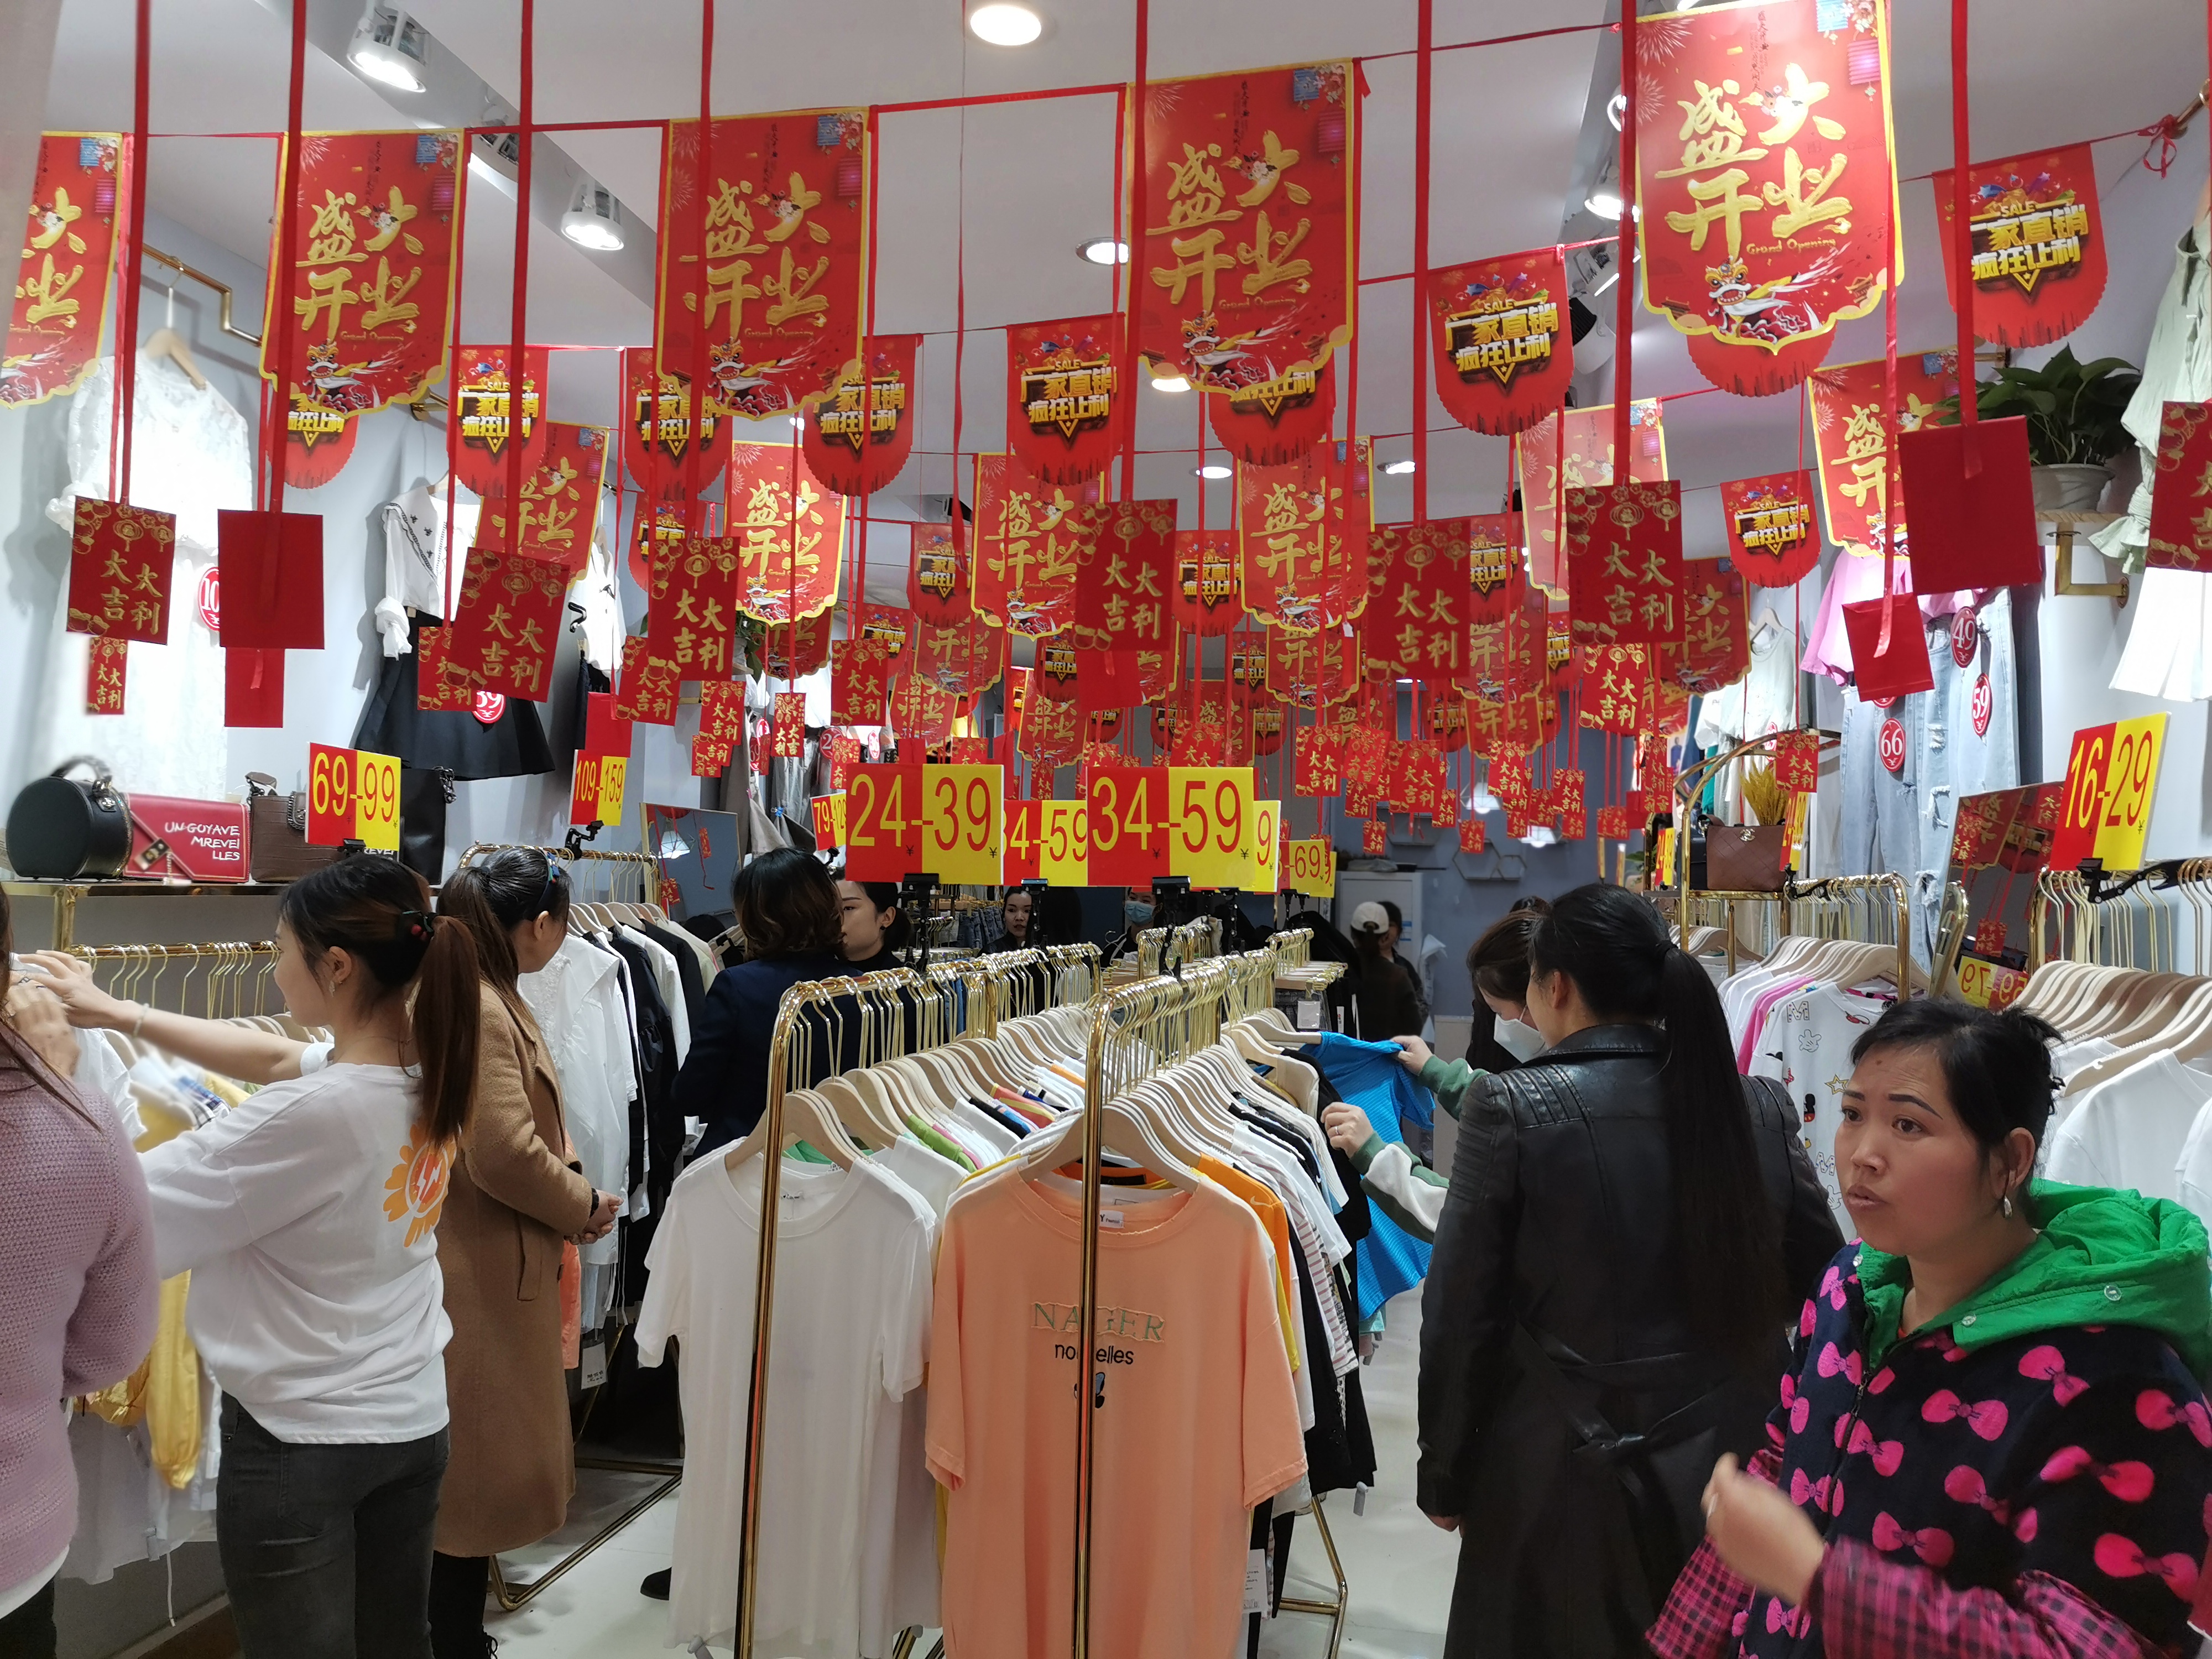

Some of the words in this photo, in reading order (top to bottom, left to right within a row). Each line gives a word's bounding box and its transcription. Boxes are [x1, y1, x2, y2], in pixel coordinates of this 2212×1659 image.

[1656, 62, 1846, 178] 盛大
[1146, 130, 1311, 236] 盛大
[1665, 148, 1853, 258] 开业
[295, 186, 424, 267] 盛大
[679, 171, 830, 262] 盛大
[2000, 201, 2036, 216] SALE
[1150, 210, 1312, 312] 开业
[1746, 242, 1782, 255] Grand
[1788, 238, 1836, 252] Opening
[1971, 237, 2081, 280] 疯狂让利
[295, 255, 422, 341] 开业
[684, 247, 829, 340] 开业
[1219, 298, 1250, 310] Grand
[1255, 296, 1297, 309] Opening
[1484, 299, 1512, 312] SALE
[1445, 304, 1559, 348] 厂家直销
[1055, 359, 1081, 371] SALE
[1455, 333, 1550, 372] 疯狂让利
[1021, 366, 1117, 401] 厂家直销
[1029, 393, 1109, 422] 疯狂让利
[733, 478, 824, 526] 盛大
[984, 488, 1079, 540] 盛大
[1251, 476, 1343, 537] 盛大
[1734, 505, 1810, 534] 厂家直销
[740, 524, 822, 575] 开业
[1255, 524, 1342, 583] 开业
[1743, 523, 1805, 547] 疯狂让利
[987, 533, 1078, 587] 开业
[1602, 541, 1636, 625] 大吉
[101, 549, 133, 622] 大吉
[131, 564, 163, 634] 大利
[1103, 554, 1131, 632] 大吉
[1132, 561, 1162, 639] 大利
[1638, 549, 1674, 633] 大利
[481, 604, 514, 676] 大吉
[674, 588, 700, 664] 大吉
[698, 597, 727, 672] 大利
[1395, 583, 1426, 663] 大吉
[1427, 589, 1459, 669] 大利
[1952, 618, 1976, 649] 49
[510, 618, 546, 692] 大利
[96, 663, 109, 705] 大吉
[108, 667, 122, 709] 大利
[846, 670, 864, 715] 大吉
[864, 675, 881, 721] 大利
[1600, 669, 1619, 720] 大吉
[1618, 677, 1637, 729] 大利
[1973, 685, 1989, 718] 59
[713, 703, 727, 736] 大吉
[724, 707, 739, 741] 大利
[1881, 729, 1903, 757] 66
[312, 752, 395, 823] 69-99
[576, 759, 624, 804] 109-159
[1309, 751, 1322, 788] 大吉
[1323, 755, 1337, 792] 大利
[1403, 766, 1418, 803] 大吉
[1419, 770, 1434, 808] 大利
[1499, 761, 1510, 790] 大吉
[1510, 766, 1521, 796] 大利
[1788, 755, 1801, 785] 大吉
[1801, 759, 1814, 789] 大利
[2066, 730, 2152, 829] 16-29
[849, 774, 991, 852] 24-39
[1092, 776, 1240, 853] 34-59
[1562, 786, 1571, 810] 大吉
[1571, 789, 1580, 813] 大利
[212, 850, 240, 860] LLES
[1004, 807, 1087, 862] 4-59
[1055, 1344, 1134, 1365] noelles
